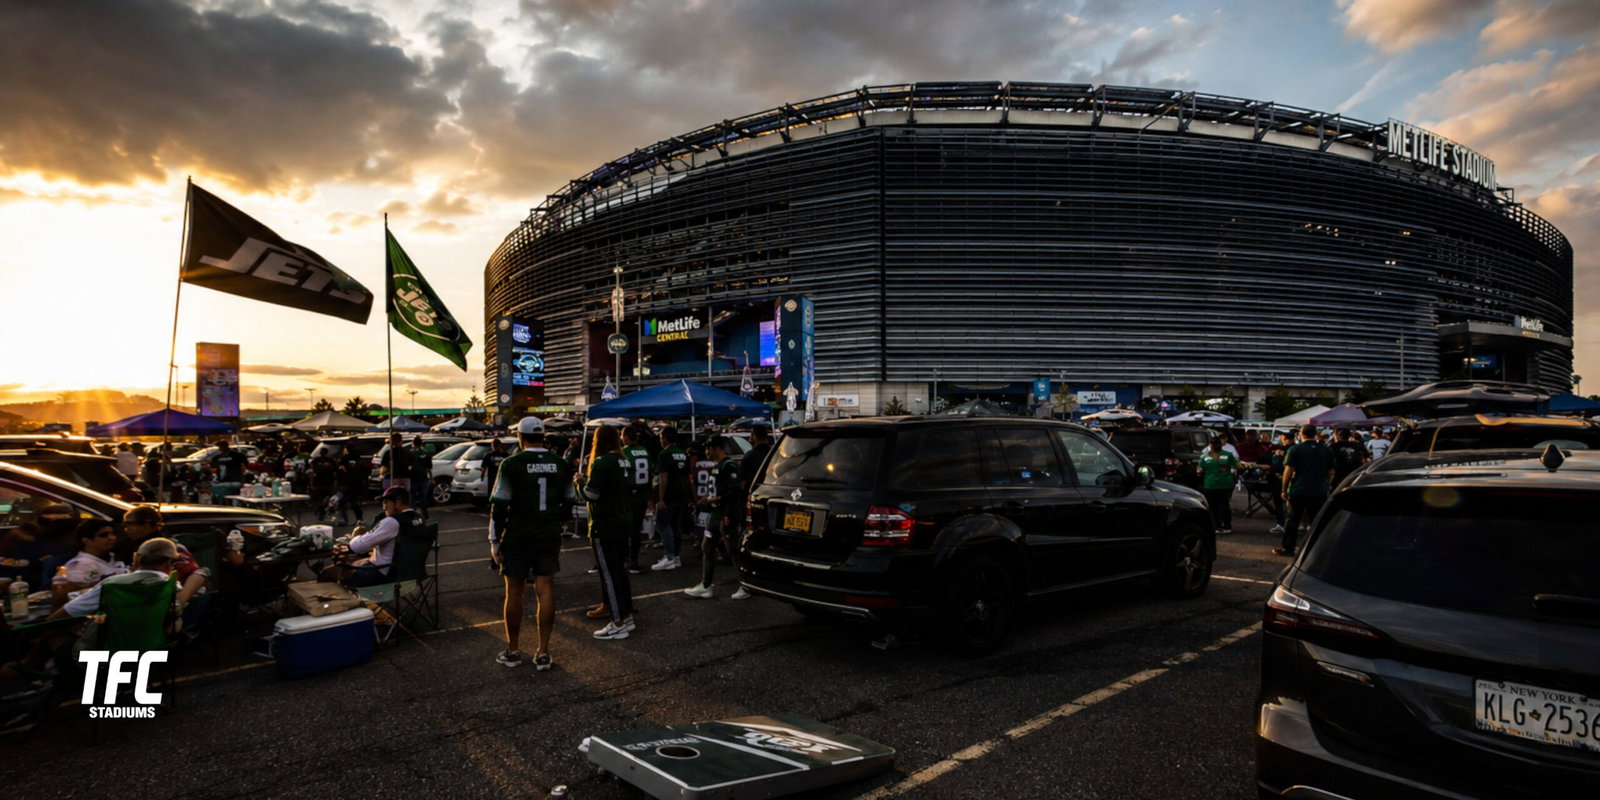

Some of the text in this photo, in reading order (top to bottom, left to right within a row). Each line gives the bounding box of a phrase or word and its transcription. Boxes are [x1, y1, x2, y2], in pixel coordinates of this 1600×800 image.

[1388, 121, 1498, 191] METLIFE STADIUM
[657, 316, 701, 333] MetLife
[634, 458, 649, 484] 8
[537, 477, 548, 511] 1
[1484, 692, 1526, 726] KLG
[1510, 686, 1540, 698] NEW
[1542, 691, 1576, 704] YORK
